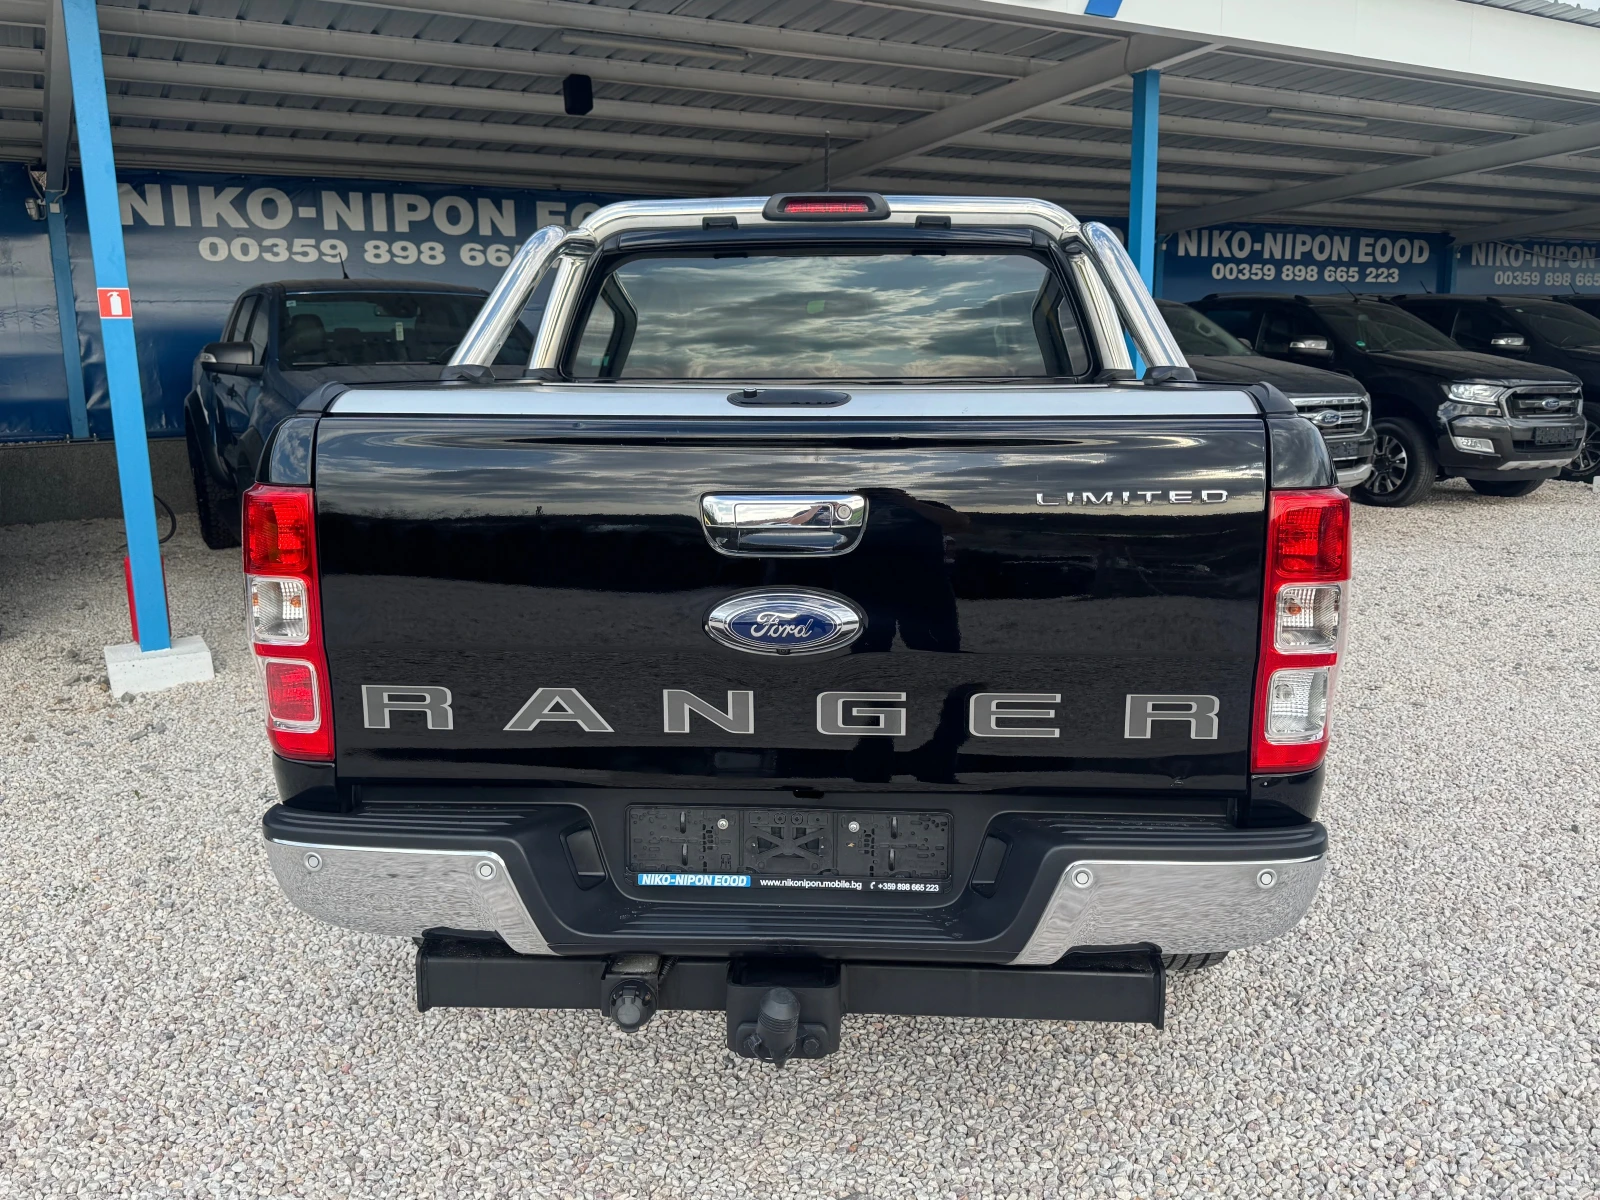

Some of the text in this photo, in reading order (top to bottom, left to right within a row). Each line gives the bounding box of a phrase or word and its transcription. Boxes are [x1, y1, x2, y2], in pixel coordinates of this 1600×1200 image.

[118, 183, 516, 238] NIKO-NIPON
[198, 236, 524, 268] 00359 898 66
[1177, 229, 1430, 264] NIKO-NIPON EOOD
[1471, 242, 1596, 269] NIKO-NIPON
[1211, 263, 1400, 284] 00359 898 665 223
[1494, 271, 1540, 286] 00359
[1544, 272, 1571, 286] 898
[1036, 489, 1229, 506] LIMITED
[750, 611, 814, 638] Ford
[360, 684, 1220, 740] RANGER
[642, 873, 747, 887] NIKO-NIPON EOOD
[760, 879, 939, 892] www.nikonipon.mobile.bg +359 898 665 223
